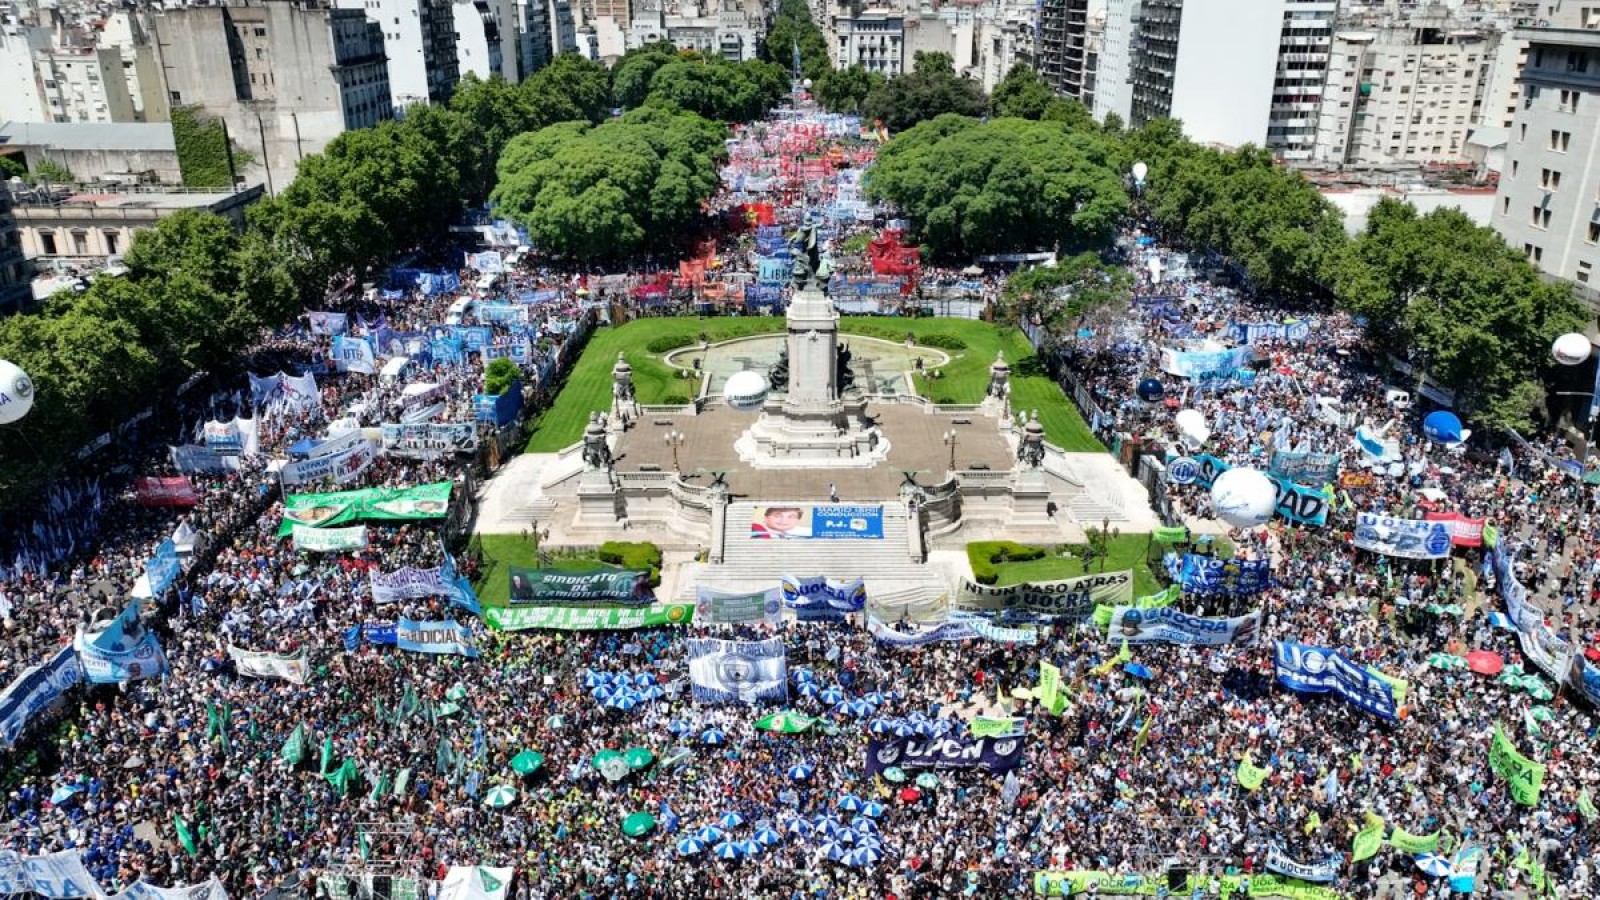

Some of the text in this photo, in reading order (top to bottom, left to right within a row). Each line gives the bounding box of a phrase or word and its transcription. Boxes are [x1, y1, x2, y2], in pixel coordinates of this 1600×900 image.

[543, 572, 618, 585] SINDICATO
[965, 573, 1129, 597] NI UN PASO ATRAS
[1023, 589, 1091, 609] UOCRA
[1160, 607, 1229, 634] UOCRA
[904, 737, 985, 759] UPCN
